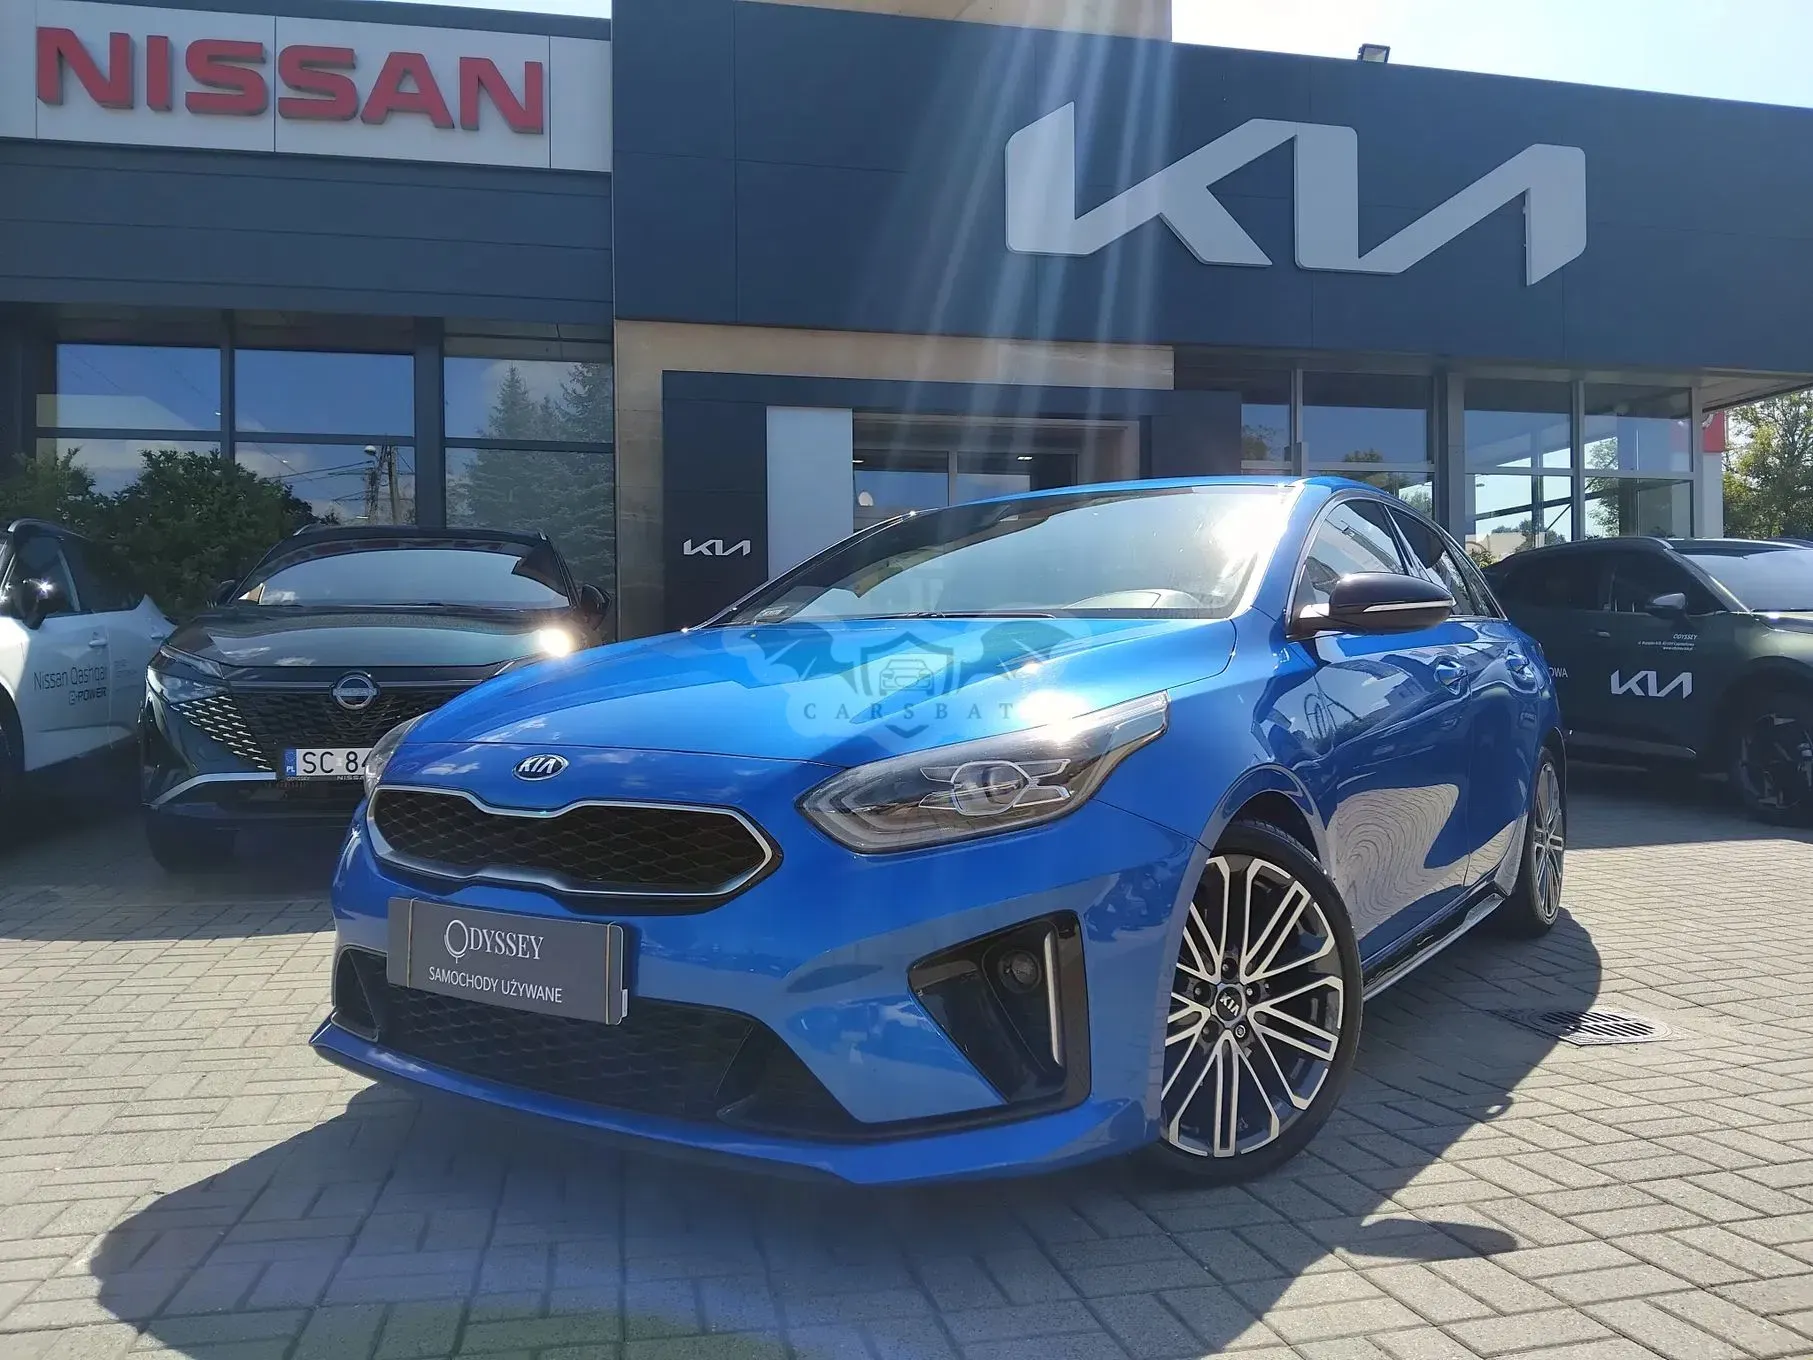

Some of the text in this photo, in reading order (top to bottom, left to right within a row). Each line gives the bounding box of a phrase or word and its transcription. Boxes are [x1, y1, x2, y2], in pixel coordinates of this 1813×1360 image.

[37, 26, 544, 135] NISSAN
[1004, 101, 1587, 286] KIA
[683, 539, 751, 556] KIA
[33, 671, 68, 691] Nissan
[1610, 669, 1693, 699] KIA
[286, 765, 296, 773] PL
[302, 751, 335, 774] SC
[518, 757, 556, 774] KIA
[444, 919, 544, 961] ODYSSEY
[428, 966, 562, 1004] SAMOCHODY UŻYWANE
[1220, 993, 1240, 1017] KIA
